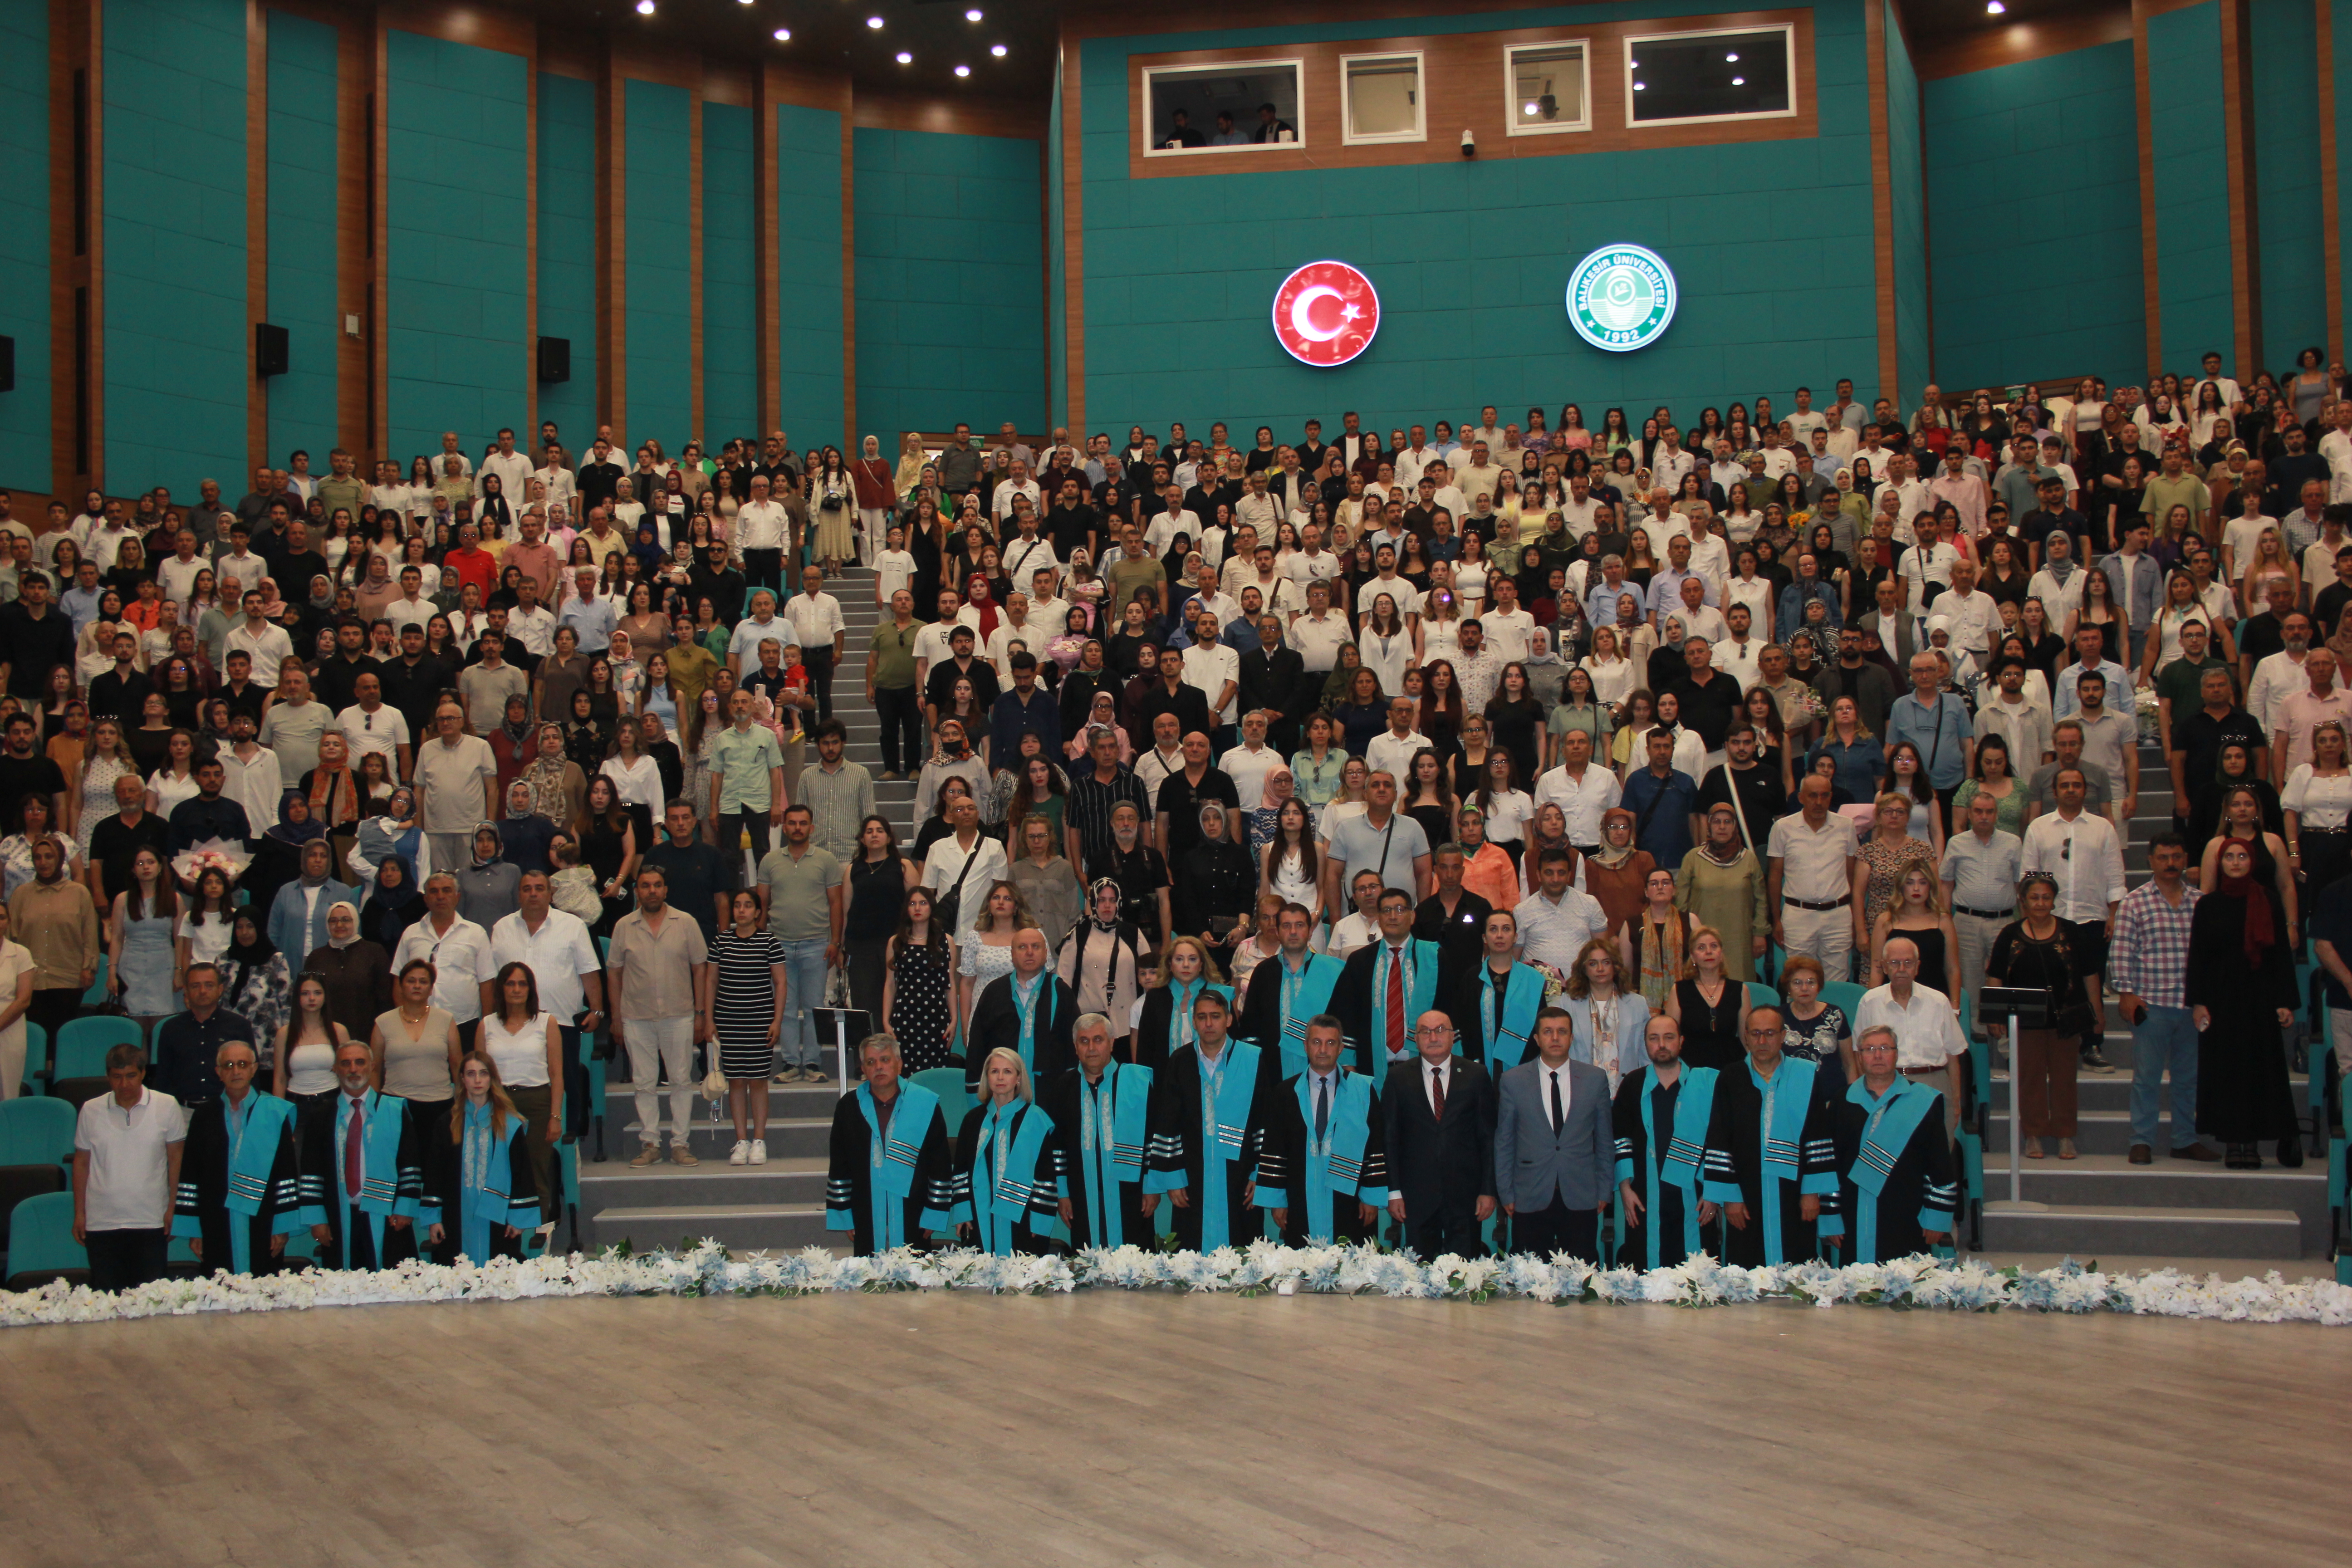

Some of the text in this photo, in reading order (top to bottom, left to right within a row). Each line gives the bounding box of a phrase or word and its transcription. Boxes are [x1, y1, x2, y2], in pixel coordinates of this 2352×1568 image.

[1578, 254, 1666, 311] BALIKESİR ÜNİVERSİTESİ
[1603, 329, 1640, 342] 1992
